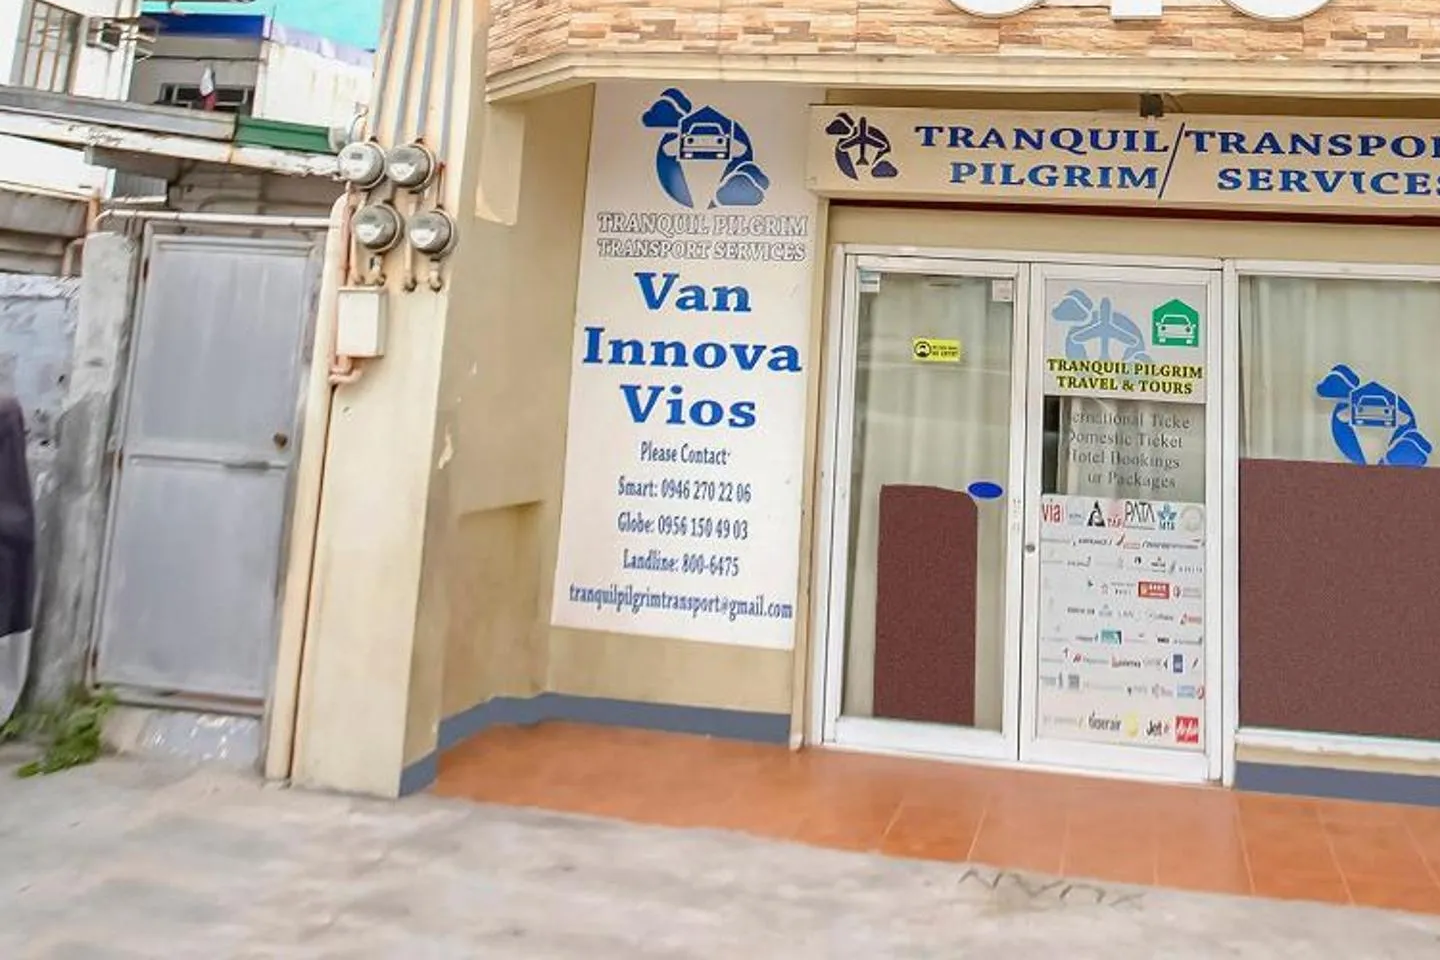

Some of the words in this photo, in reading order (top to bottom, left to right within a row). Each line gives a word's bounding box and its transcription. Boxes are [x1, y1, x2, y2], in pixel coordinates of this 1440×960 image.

[915, 126, 1169, 154] TRANQUIL
[950, 162, 1157, 189] PILGRIM
[598, 212, 709, 237] TRANQUIL
[712, 215, 808, 236] PILGRIM
[597, 239, 712, 259] TRANSPORT
[713, 241, 805, 260] SERVICES
[634, 272, 752, 312] Van
[582, 327, 803, 372] Innova
[1047, 358, 1129, 375] TRANQUIL
[1134, 364, 1203, 378] PILGRIM
[1057, 376, 1118, 390] TRAVEL
[1122, 380, 1135, 391] &
[1138, 380, 1192, 394] TOURS
[620, 384, 757, 428] Vios
[640, 441, 678, 463] Please
[618, 476, 658, 497] Smart:
[693, 480, 715, 501] 270
[718, 482, 733, 502] 22
[736, 483, 751, 503] 06
[618, 512, 654, 533] Globe:
[690, 516, 712, 538] 150
[715, 518, 730, 539] 49
[732, 520, 748, 540] 03
[623, 549, 679, 572] Landline:
